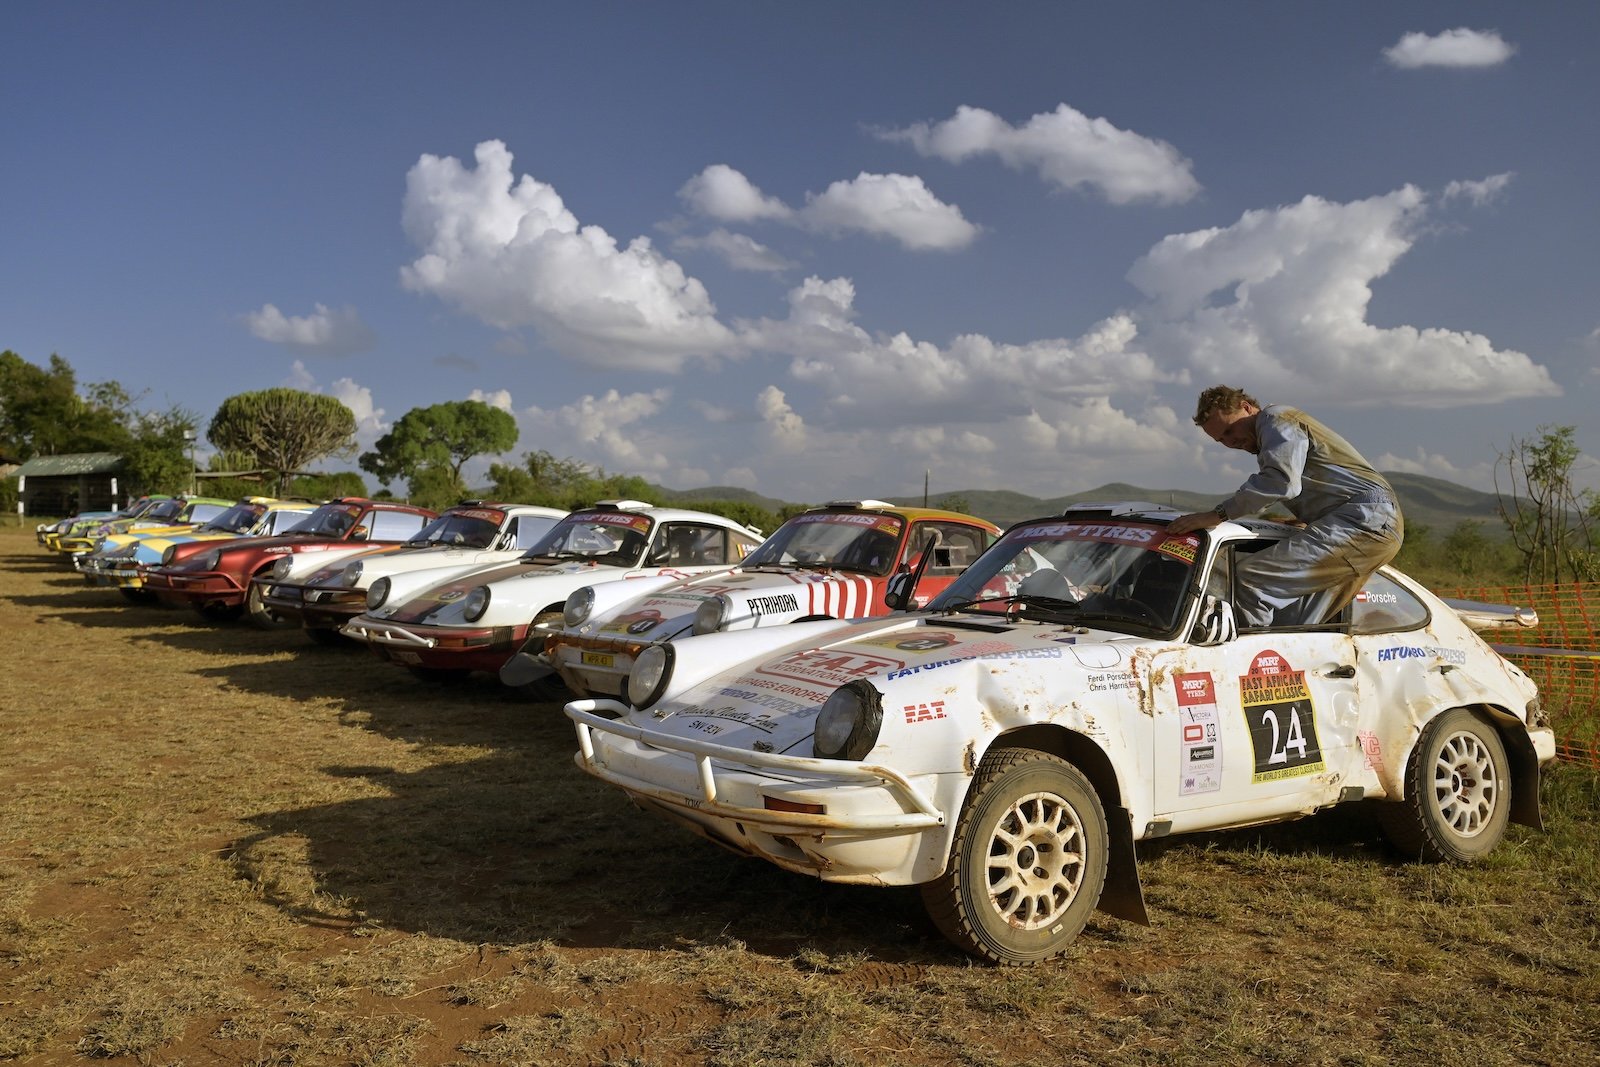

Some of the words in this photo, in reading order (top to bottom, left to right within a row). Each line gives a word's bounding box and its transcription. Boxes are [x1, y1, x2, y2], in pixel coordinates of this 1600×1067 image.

[599, 514, 634, 524] TYRES
[834, 514, 878, 525] TYRES
[1015, 524, 1079, 539] MRF
[1077, 525, 1157, 542] TYRES
[1366, 590, 1397, 604] Porsche
[746, 593, 799, 617] PETRIHORN
[631, 619, 653, 631] 41
[1378, 646, 1426, 662] FATURBO
[887, 656, 977, 681] FATURBO
[980, 647, 1062, 660] EXPRESS
[1257, 656, 1279, 667] MRF
[769, 662, 851, 684] INTERNATIONAL
[1262, 666, 1279, 675] TYRES
[1087, 674, 1105, 682] Ferdi
[1106, 673, 1132, 681] Porsche
[1241, 676, 1263, 690] EAST
[1266, 673, 1302, 688] AFRICAN
[1089, 682, 1107, 692] Chris
[1109, 682, 1129, 690] Harris
[1181, 679, 1207, 690] MRF
[1243, 690, 1274, 704] SAFARI
[1274, 685, 1307, 700] CLASSIC
[904, 700, 947, 723] F.A.T.
[1262, 706, 1307, 765] 24
[1254, 772, 1262, 782] THE
[1262, 770, 1281, 781] WORLD'S
[685, 797, 702, 808] TOW
